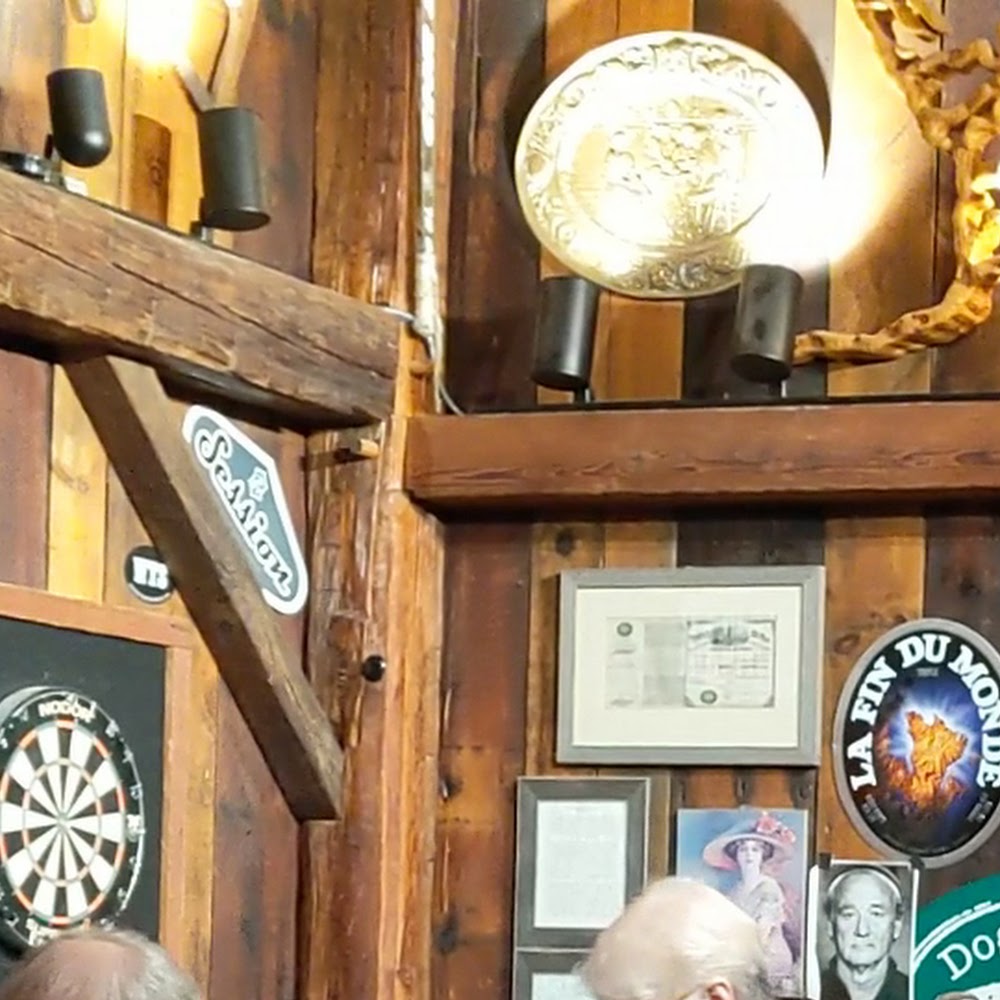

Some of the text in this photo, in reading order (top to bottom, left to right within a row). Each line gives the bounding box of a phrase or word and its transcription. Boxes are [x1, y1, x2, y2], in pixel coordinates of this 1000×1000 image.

[196, 429, 293, 597] Session
[894, 633, 951, 669] DU
[851, 655, 898, 726] FIN
[847, 731, 877, 791] LA
